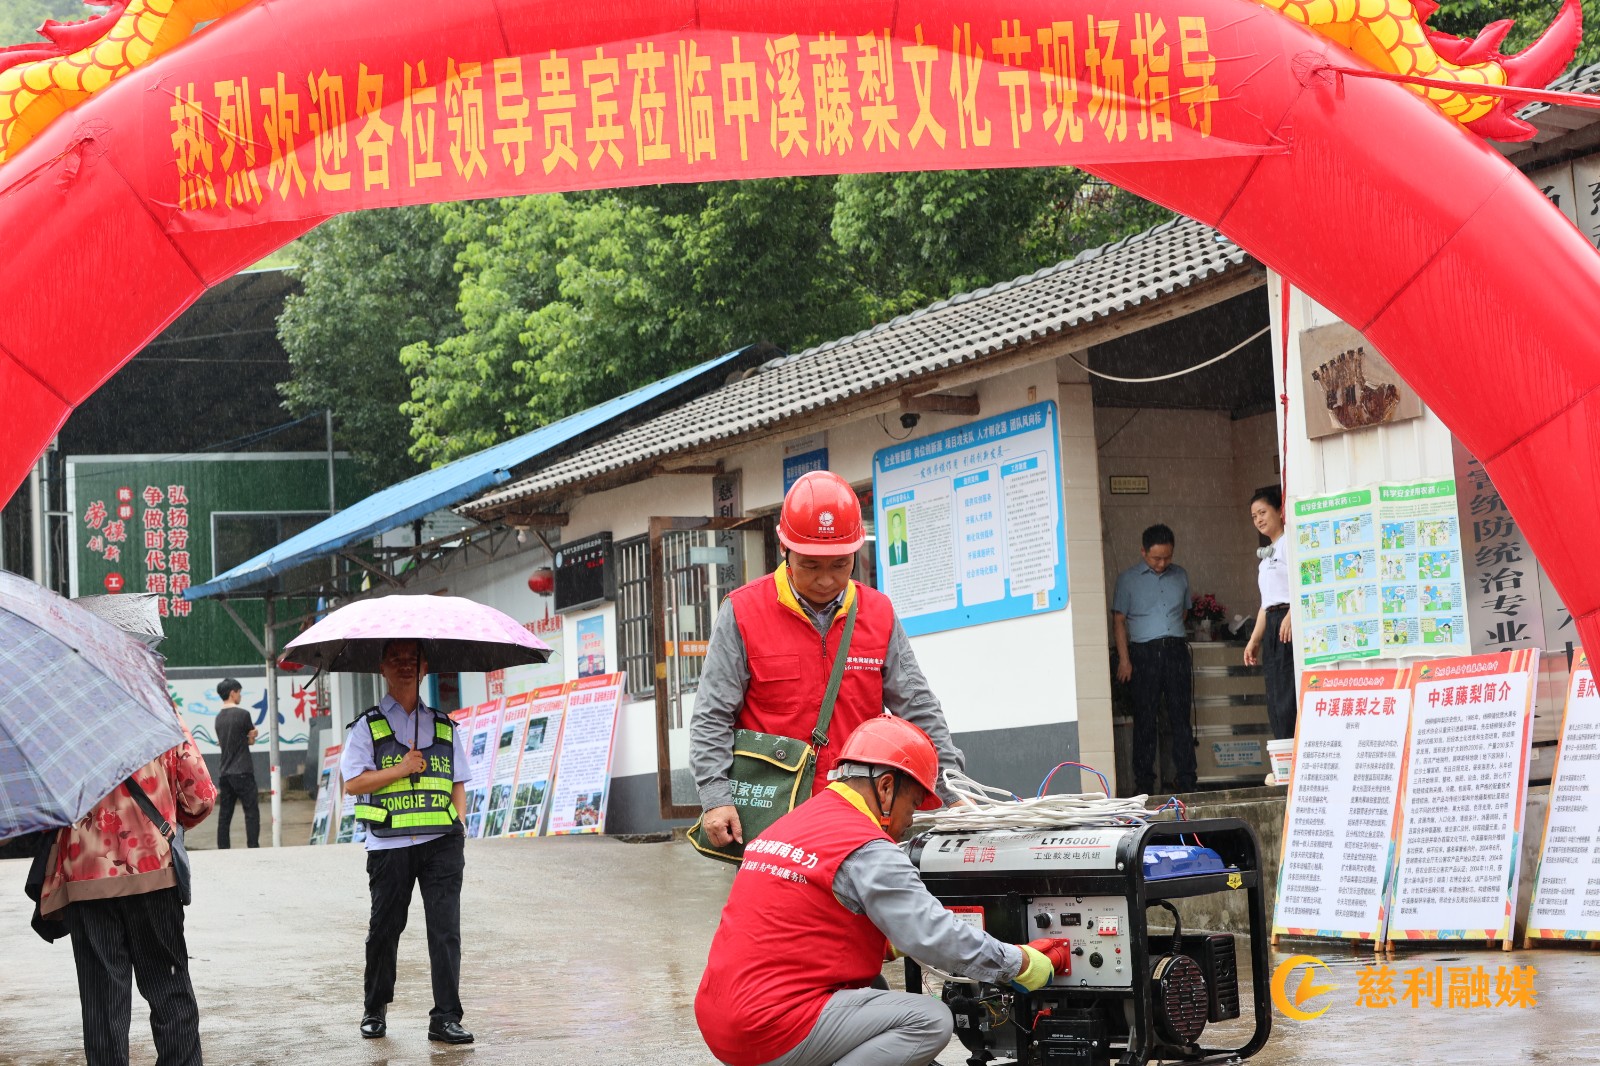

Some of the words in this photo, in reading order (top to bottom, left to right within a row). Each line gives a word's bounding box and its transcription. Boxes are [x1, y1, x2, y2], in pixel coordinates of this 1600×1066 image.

[170, 13, 1220, 212] 热烈欢迎各位领导贵宾莅临中溪藤梨文化节现场指导
[167, 485, 191, 617] 弘扬劳模精神
[1428, 680, 1511, 708] 中溪藤梨简介
[1315, 696, 1397, 717] 中溪藤梨之歌
[429, 755, 451, 774] 执法
[750, 797, 772, 808] GRID
[939, 839, 970, 852] LT
[1041, 837, 1101, 845] LT15000i
[963, 846, 996, 864] 雷腾
[1033, 852, 1101, 860] 工业款发电机组
